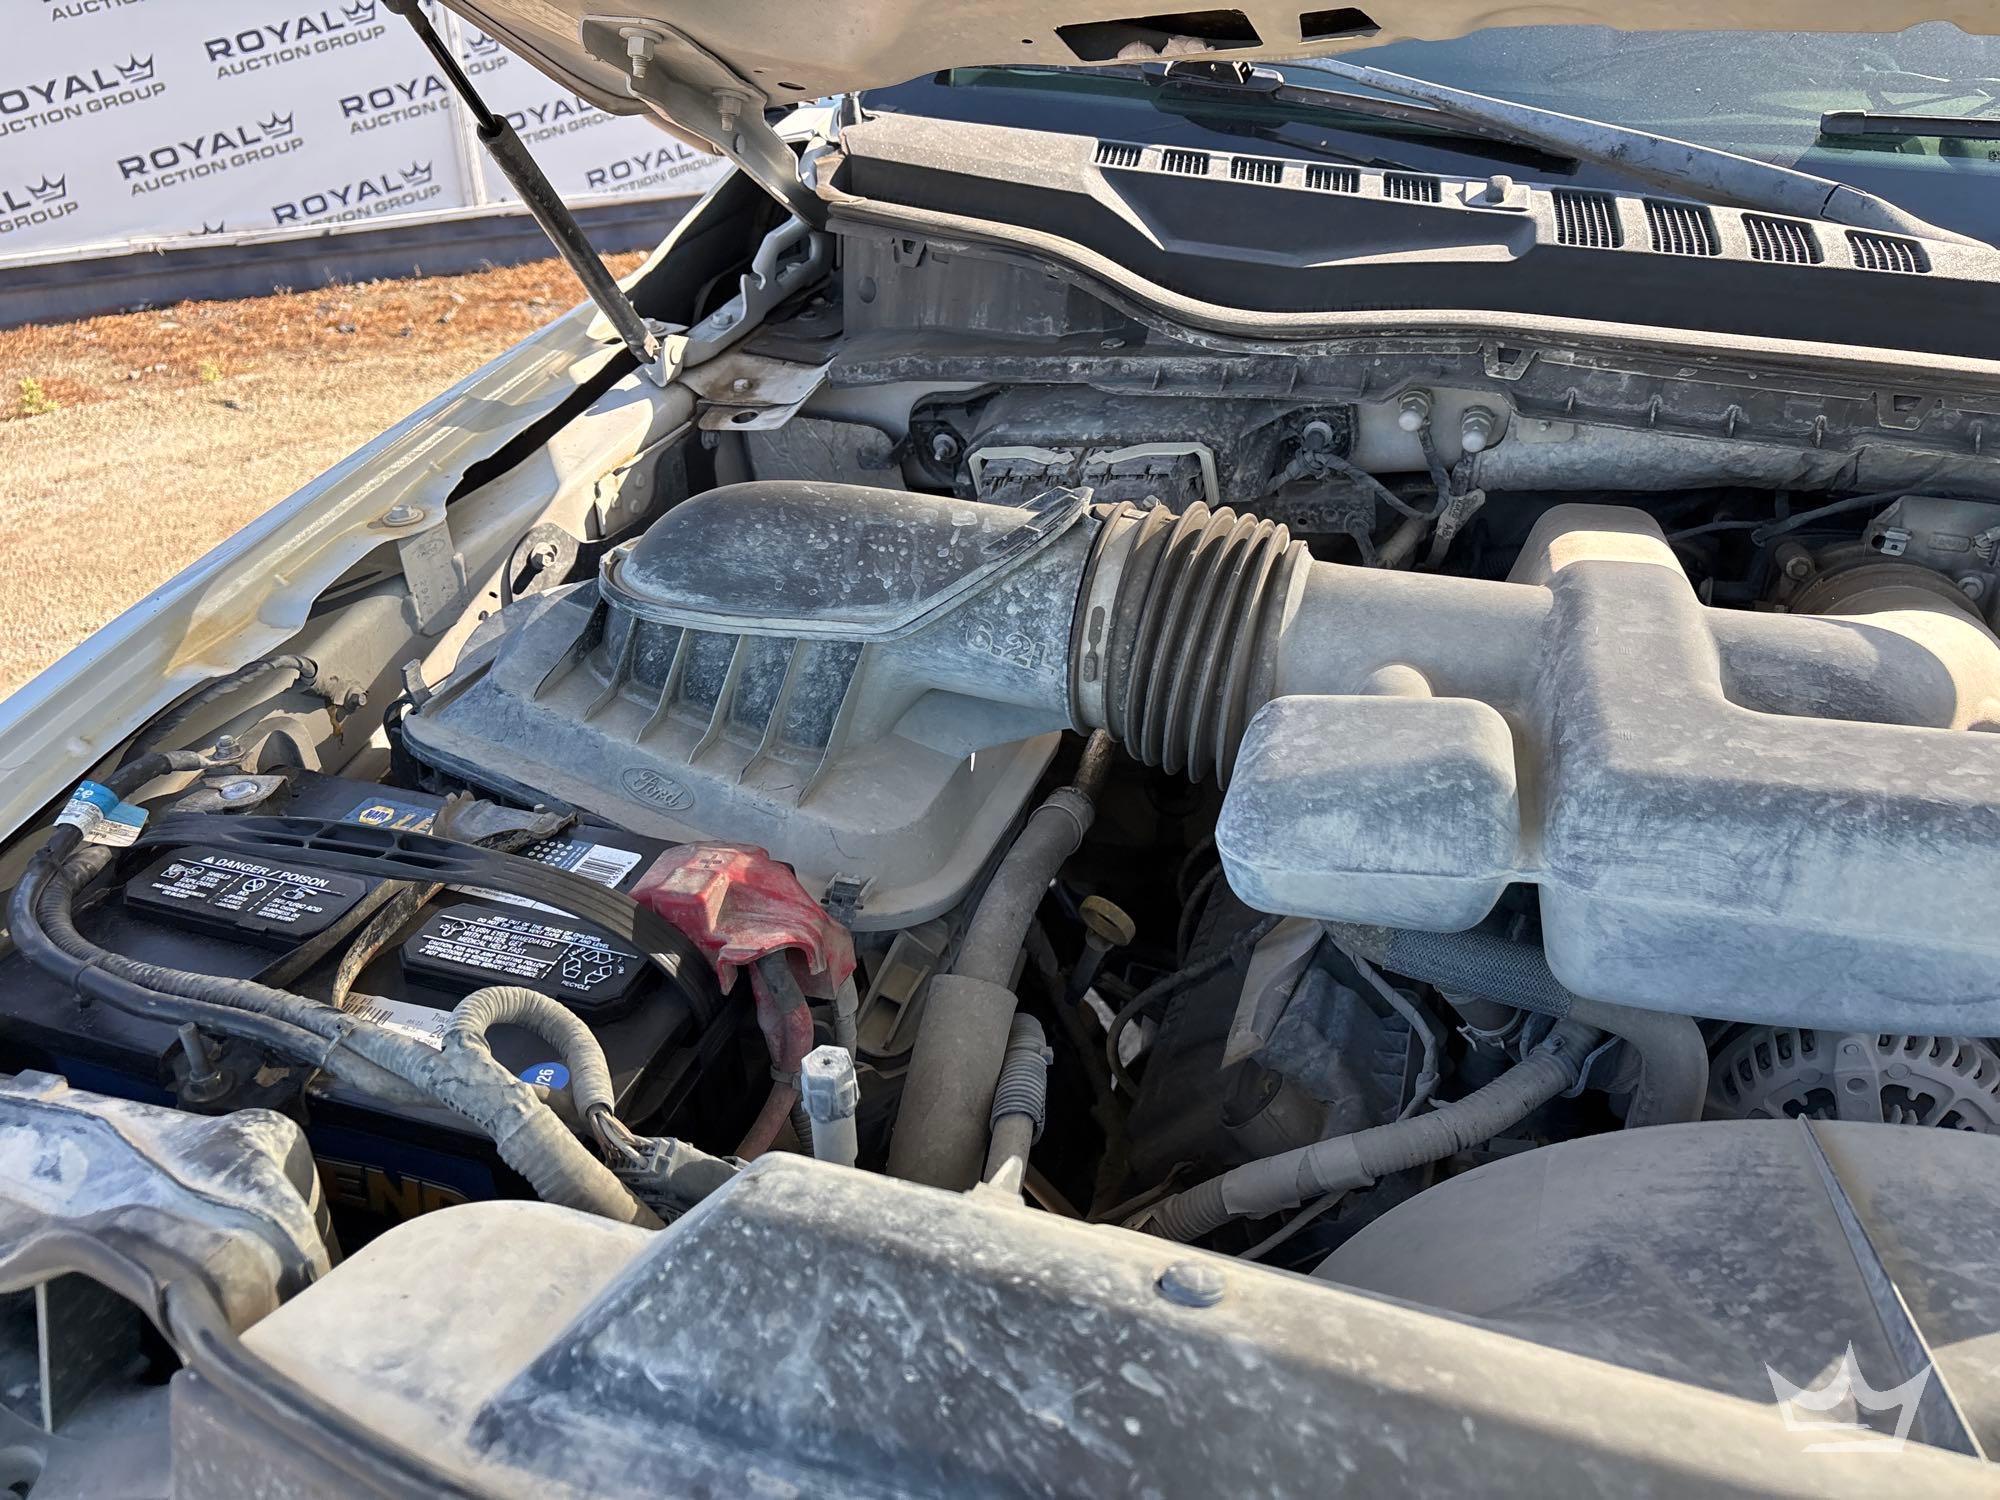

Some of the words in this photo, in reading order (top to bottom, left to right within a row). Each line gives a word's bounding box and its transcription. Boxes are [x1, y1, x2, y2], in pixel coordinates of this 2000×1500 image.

[52, 0, 143, 22] AUCT
[204, 11, 345, 62] ROYAL
[217, 44, 311, 80] AUCTION
[314, 25, 386, 56] GROUP
[0, 70, 119, 114] OYAL
[339, 75, 447, 118] ROYA
[0, 104, 82, 137] UCTION
[86, 82, 166, 113] GROUP
[350, 101, 436, 135] AUCTION
[504, 97, 593, 130] OYAL
[521, 124, 566, 144] TION
[118, 126, 261, 180] ROYAL
[131, 159, 226, 196] AUCTION
[231, 137, 304, 168] GROUP
[585, 143, 694, 188] ROYAL
[272, 175, 404, 224] ROYAL
[373, 184, 441, 213] GROUP
[0, 202, 78, 233] GROUP
[963, 617, 1059, 676] 6.2L
[633, 771, 685, 807] Ford
[362, 809, 390, 821] NAPA
[206, 871, 231, 880] SHIELD
[215, 858, 269, 875] DANGER
[278, 871, 329, 887] POISON
[305, 904, 323, 913] ACID
[457, 936, 487, 947] MEDICAL
[488, 942, 508, 950] HELP
[507, 946, 527, 954] FAST
[463, 931, 480, 939] WITH
[467, 925, 490, 935] FLUSH
[491, 930, 510, 938] EYES
[510, 934, 557, 948] IMMEDIATELY
[561, 979, 591, 991] RECYCLE
[535, 1069, 554, 1086] /26
